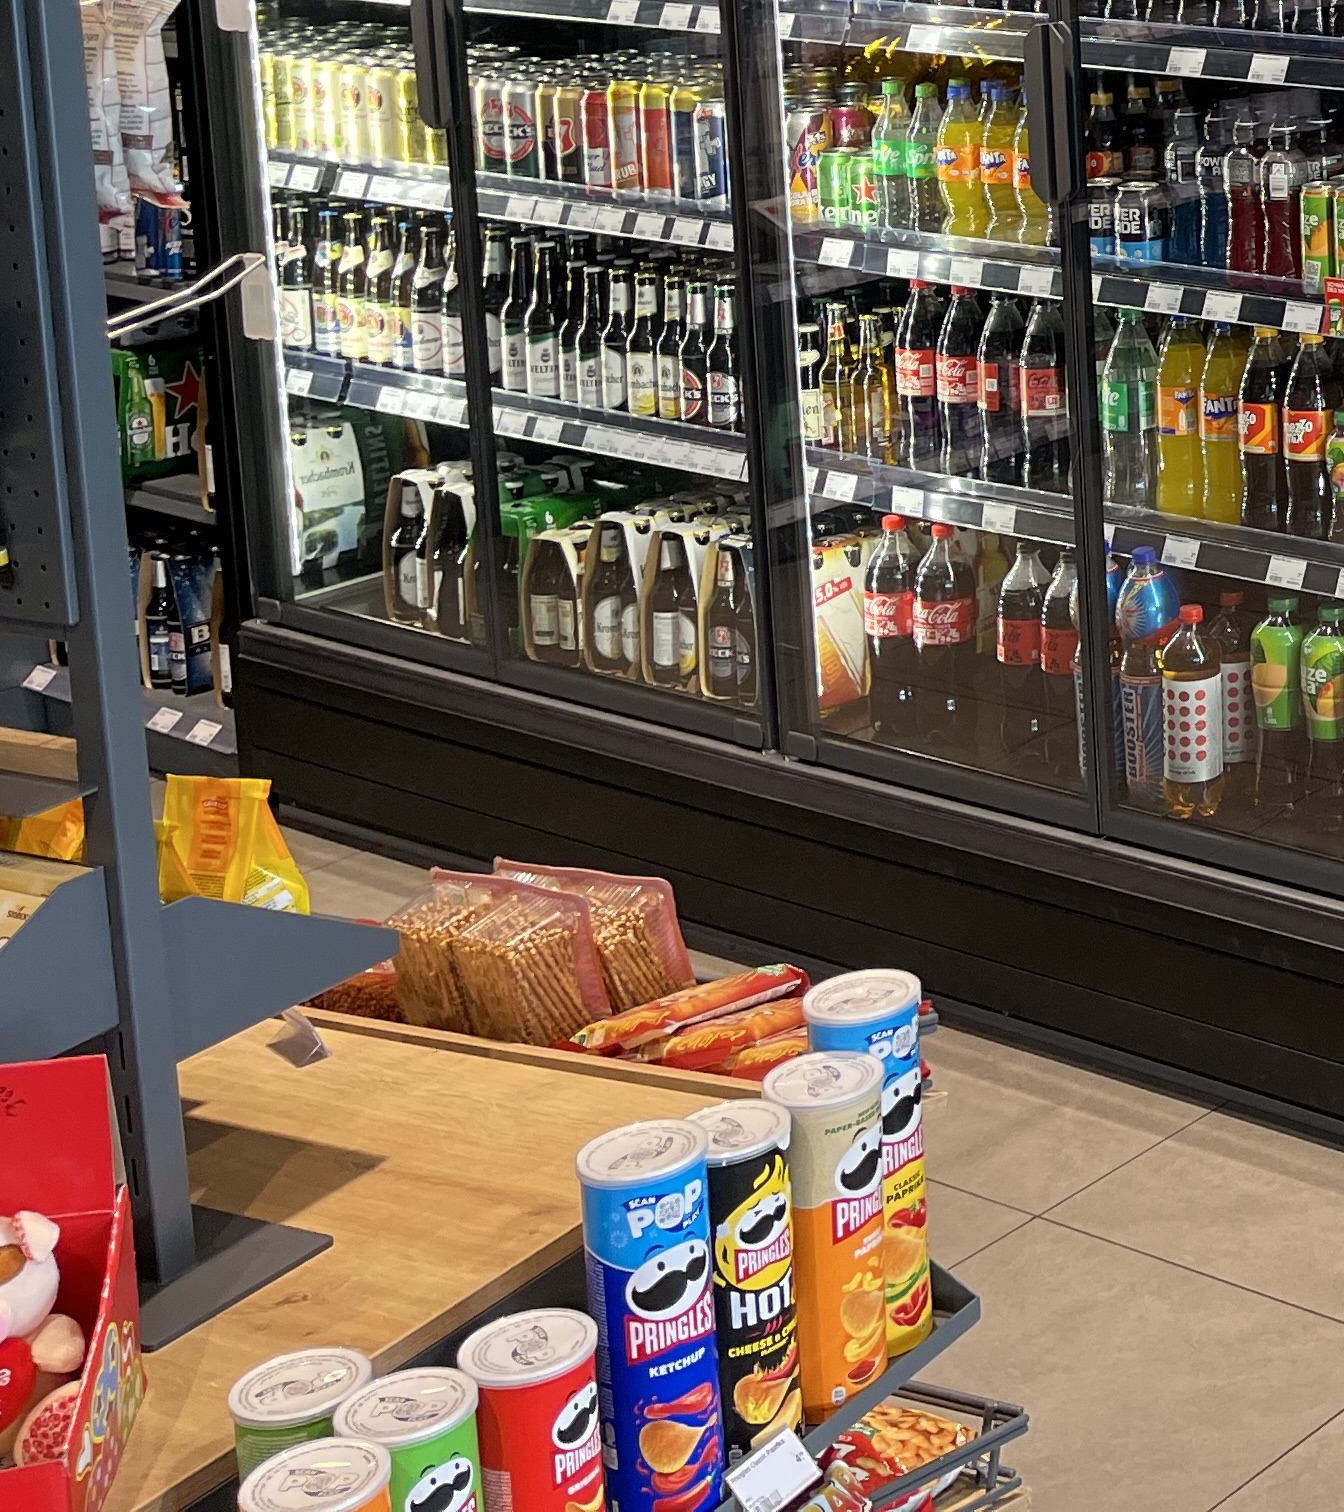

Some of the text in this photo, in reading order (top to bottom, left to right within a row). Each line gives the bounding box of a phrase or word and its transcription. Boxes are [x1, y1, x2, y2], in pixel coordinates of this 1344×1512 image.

[1122, 688, 1136, 780] BOOSTER
[870, 1027, 894, 1042] SCAN
[628, 1196, 656, 1208] SCAN
[885, 1175, 925, 1205] PAPRIKA
[737, 1230, 790, 1281] PRINGLES
[730, 1276, 792, 1330] HOT
[629, 1291, 712, 1360] PRINGLES
[649, 1346, 705, 1378] KETCHUP
[728, 1339, 774, 1359] CHEESE
